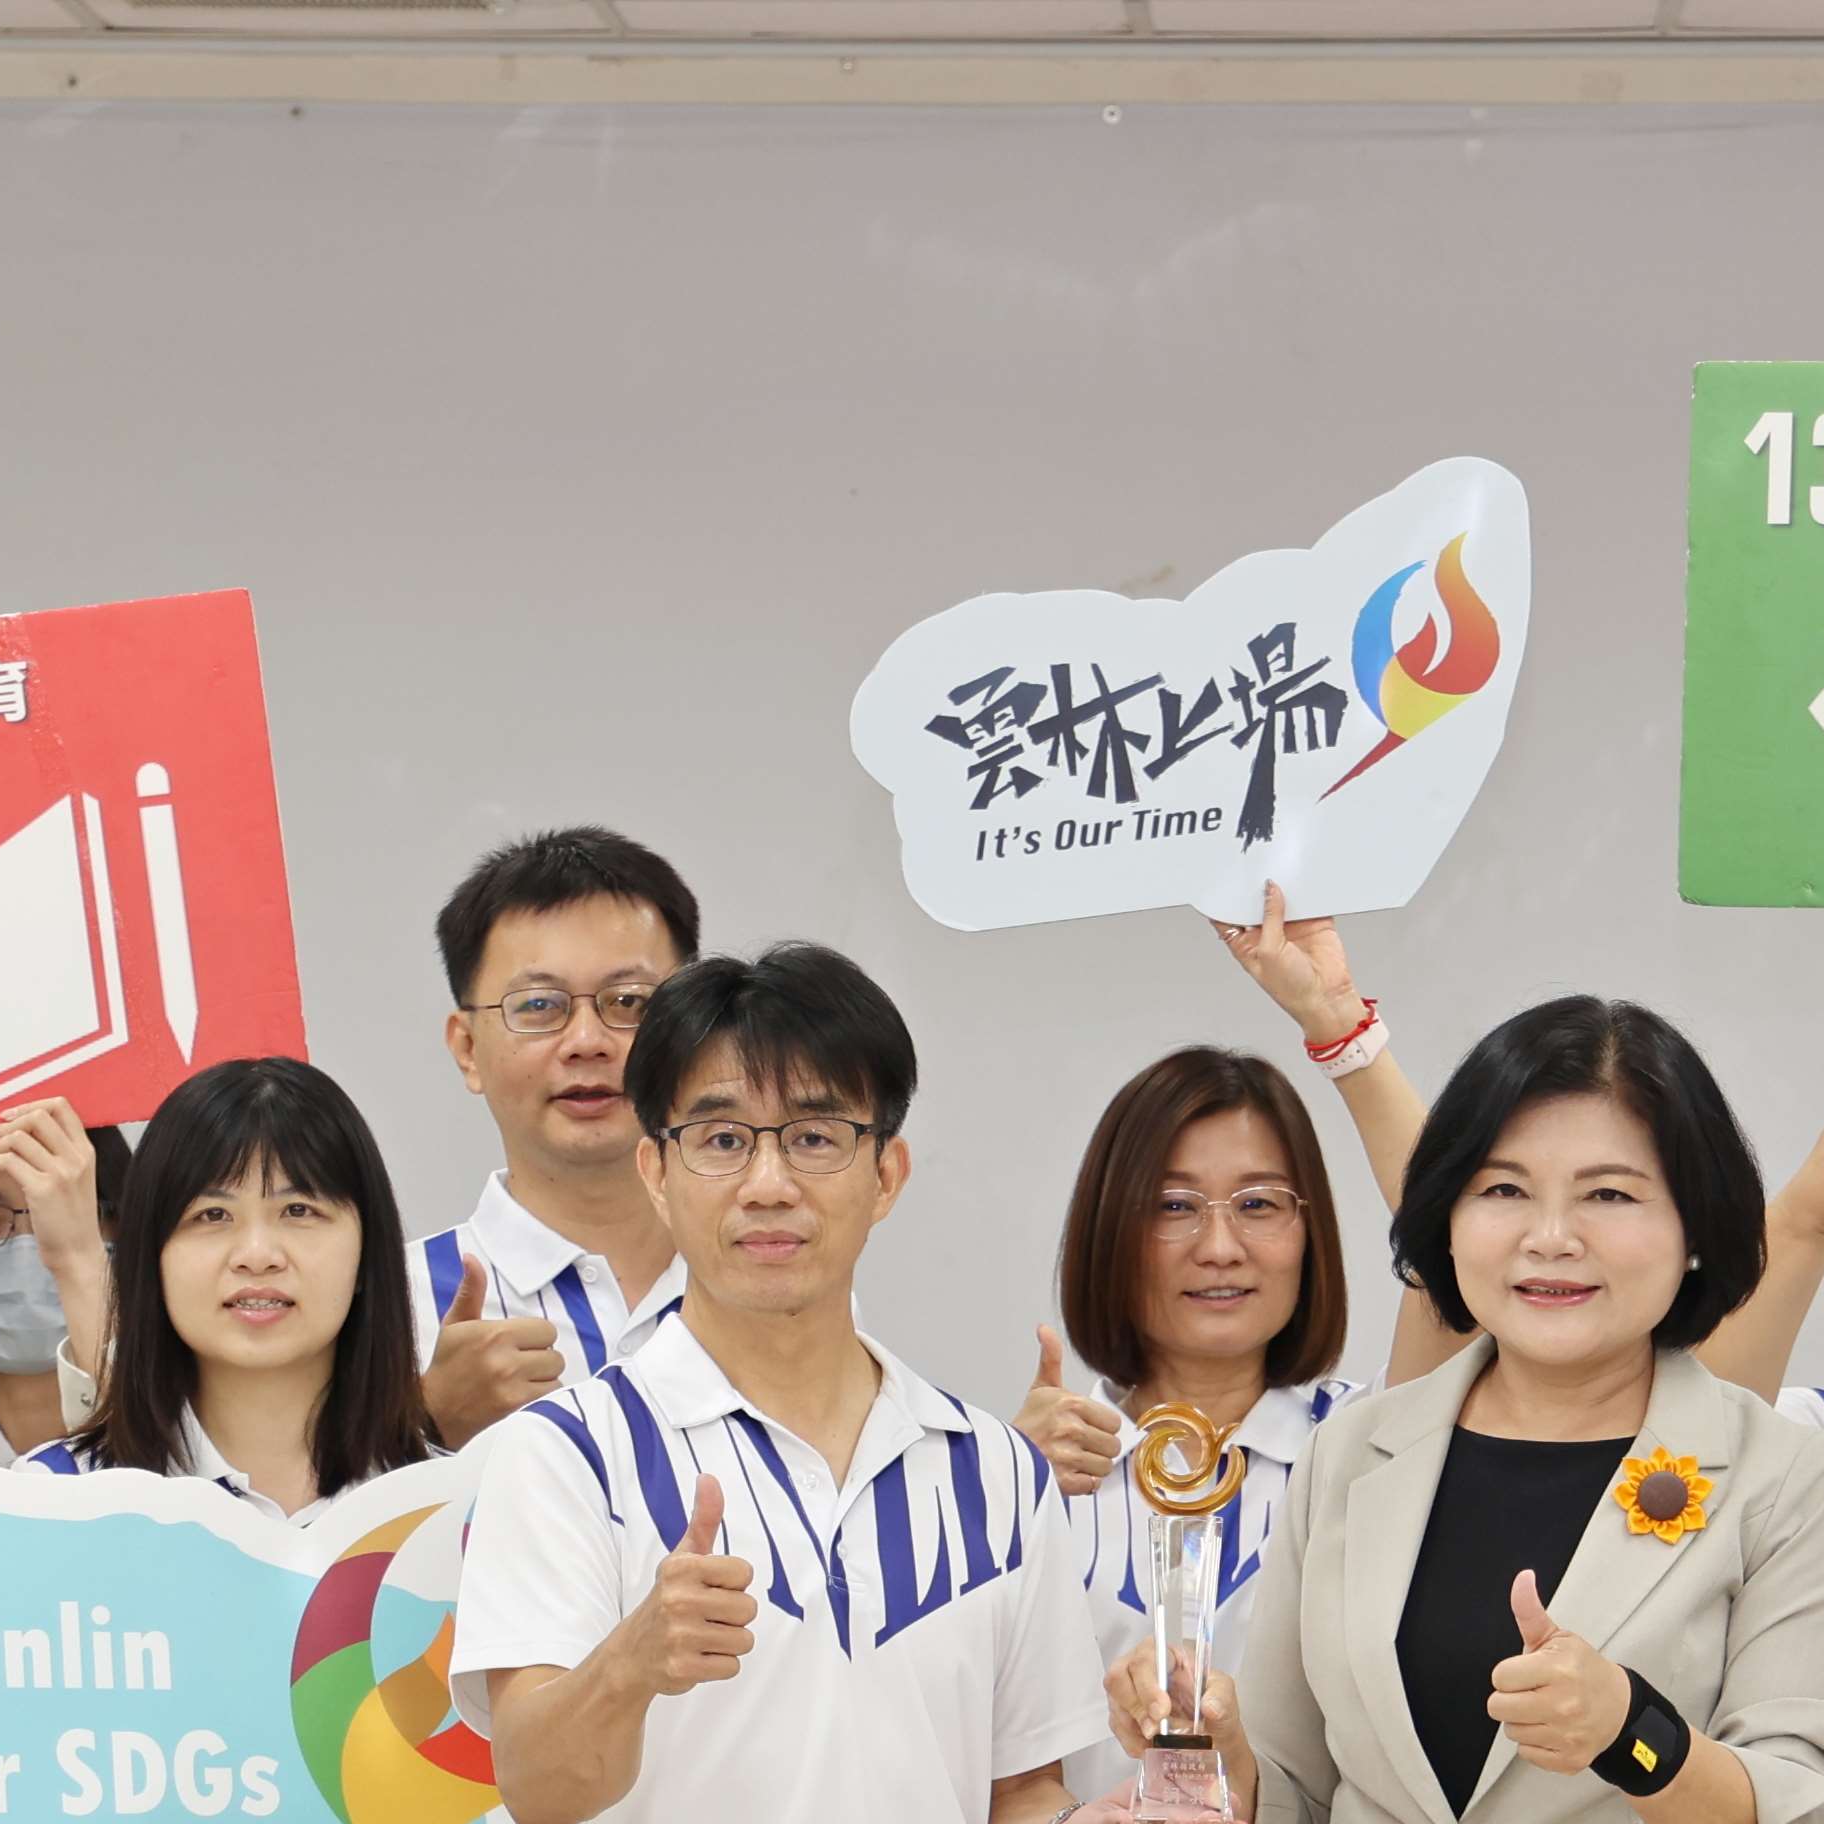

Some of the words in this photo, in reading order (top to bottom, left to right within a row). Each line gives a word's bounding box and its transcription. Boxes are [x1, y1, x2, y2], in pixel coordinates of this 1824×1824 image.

[924, 622, 1348, 852] 雲林上場
[976, 827, 1041, 861] It's
[1054, 817, 1122, 851] Our
[1133, 806, 1223, 842] Time
[56, 1728, 281, 1818] SDGs
